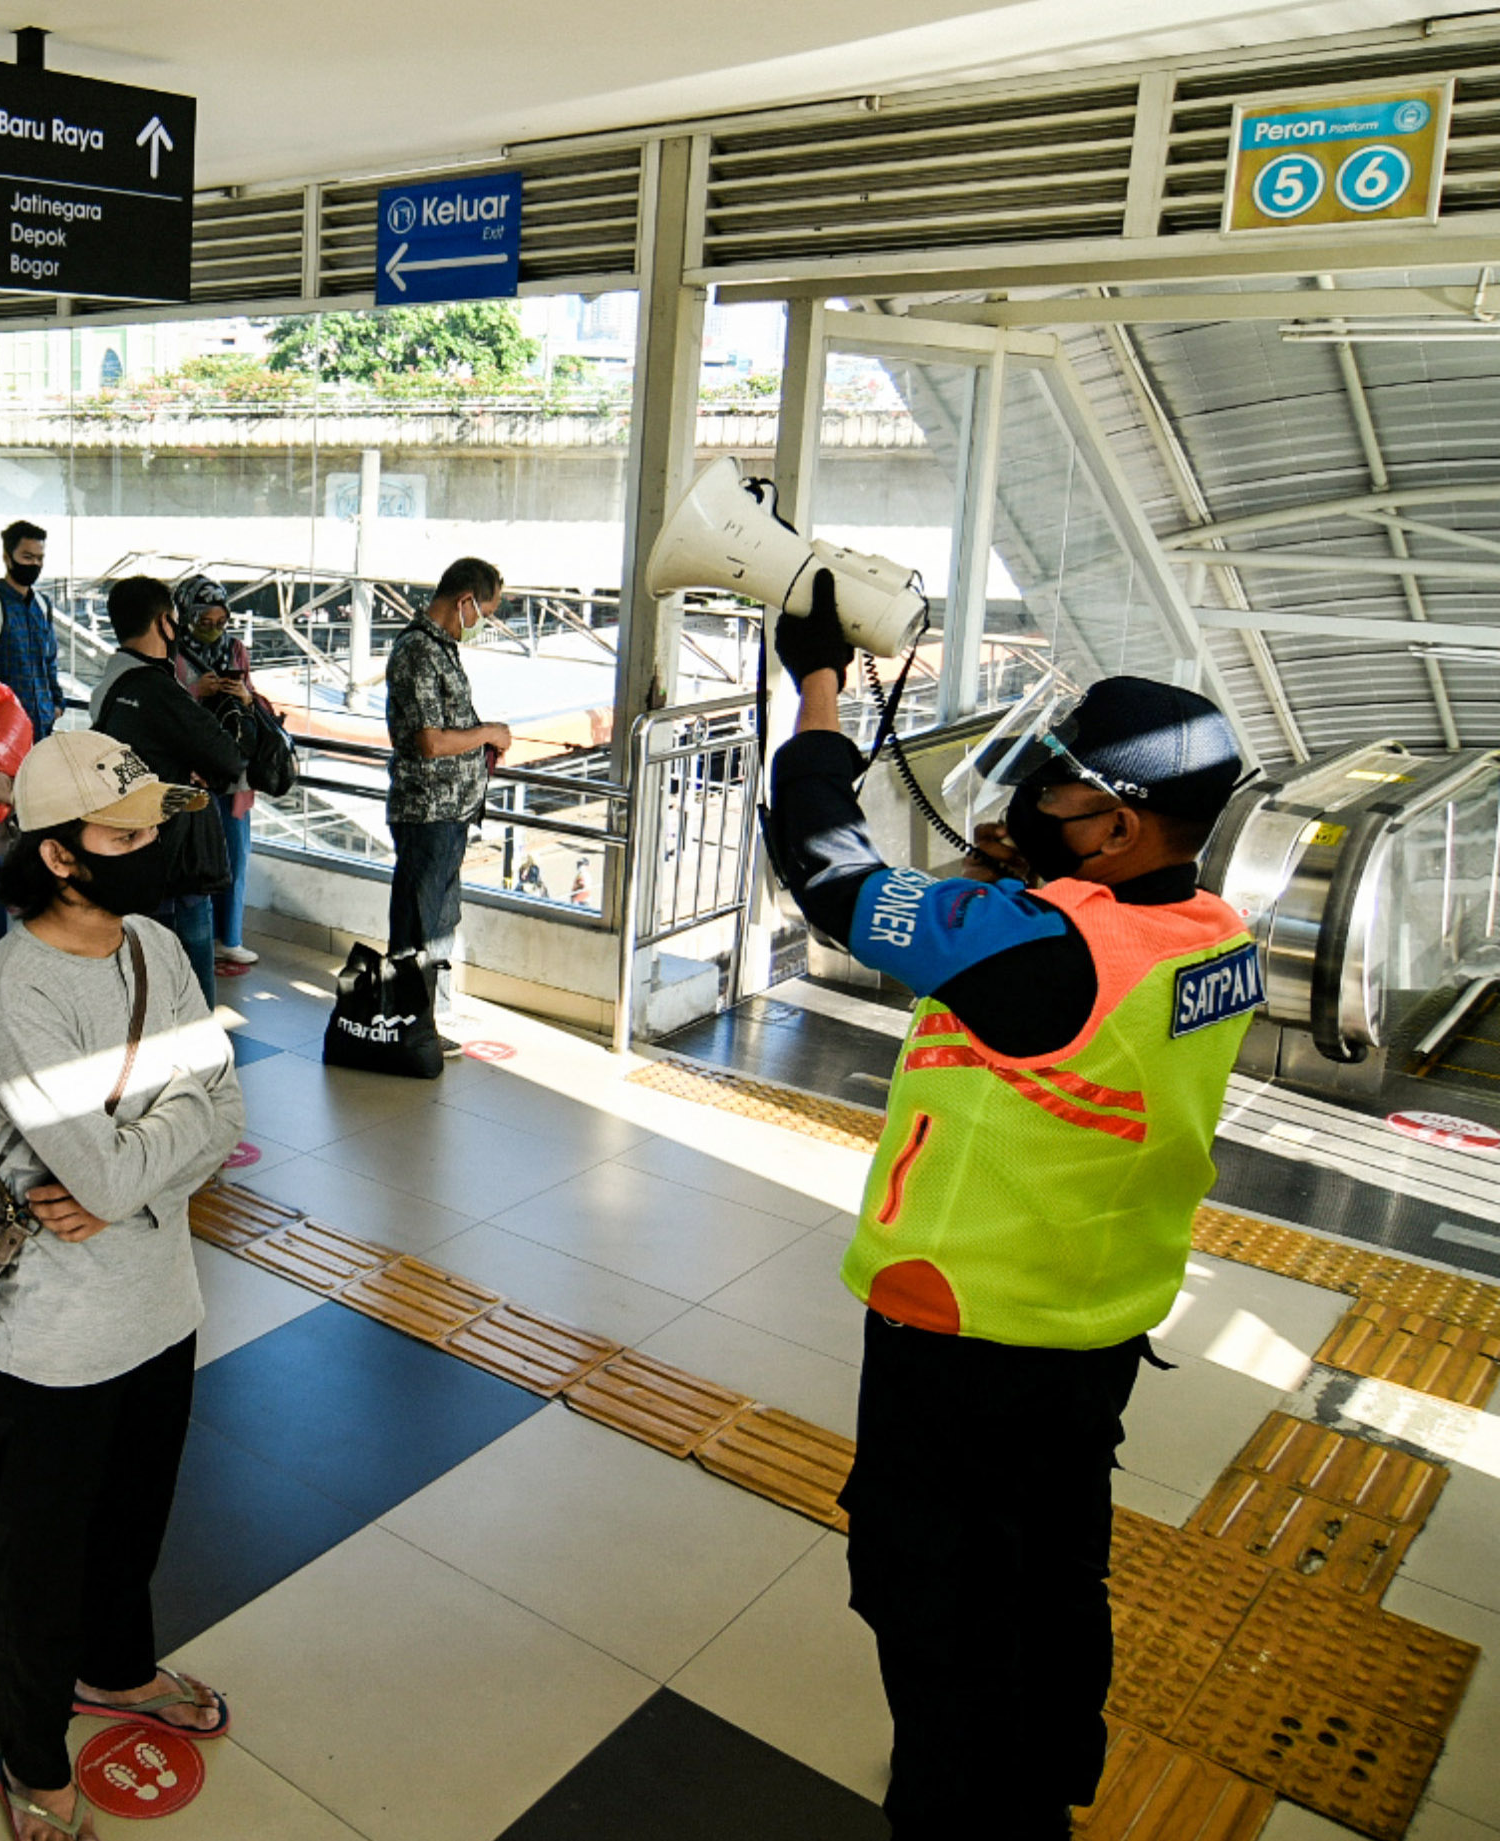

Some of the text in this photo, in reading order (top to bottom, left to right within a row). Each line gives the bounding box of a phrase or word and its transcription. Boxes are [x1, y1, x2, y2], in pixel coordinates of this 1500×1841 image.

[52, 119, 104, 152] Raya
[1254, 119, 1379, 142] Peron Platform
[1271, 155, 1389, 206] 5 6
[10, 192, 102, 222] Jatinegara
[421, 194, 510, 226] Keluar
[10, 222, 67, 248] Depok
[482, 225, 505, 240] Exit
[10, 254, 60, 280] Bogor
[1180, 956, 1258, 1024] SATPAM
